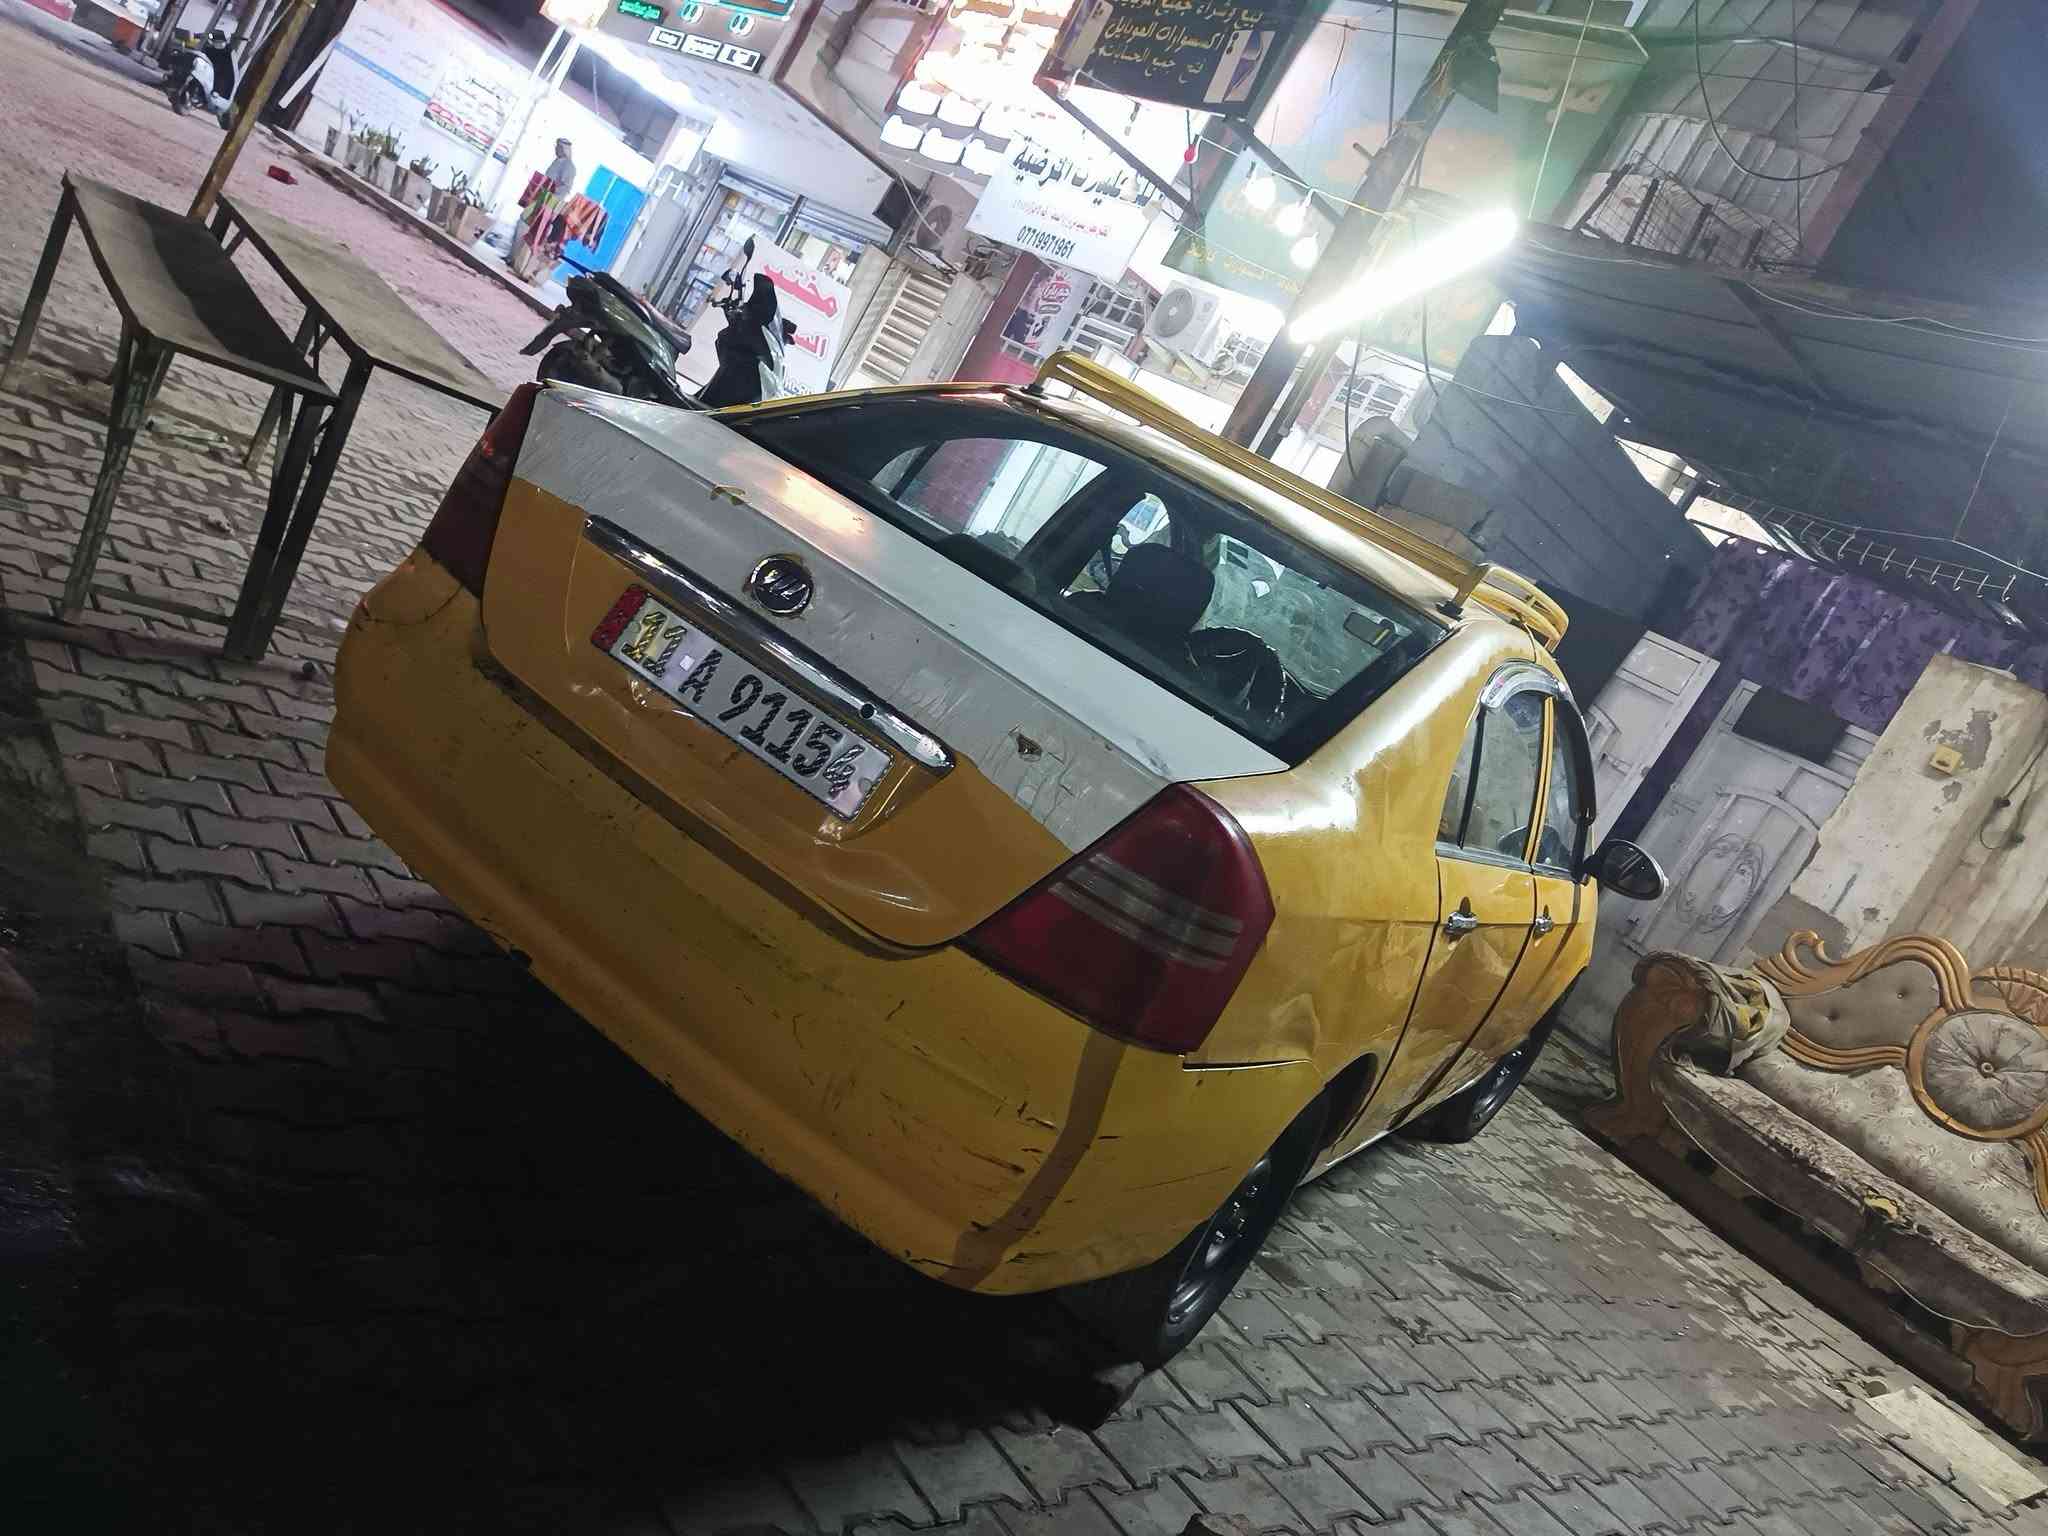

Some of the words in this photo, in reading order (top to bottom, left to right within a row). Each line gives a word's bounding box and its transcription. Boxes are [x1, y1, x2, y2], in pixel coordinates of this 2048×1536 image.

[1016, 225, 1077, 259] 07719971961
[621, 611, 687, 678] 11
[678, 649, 723, 704] A
